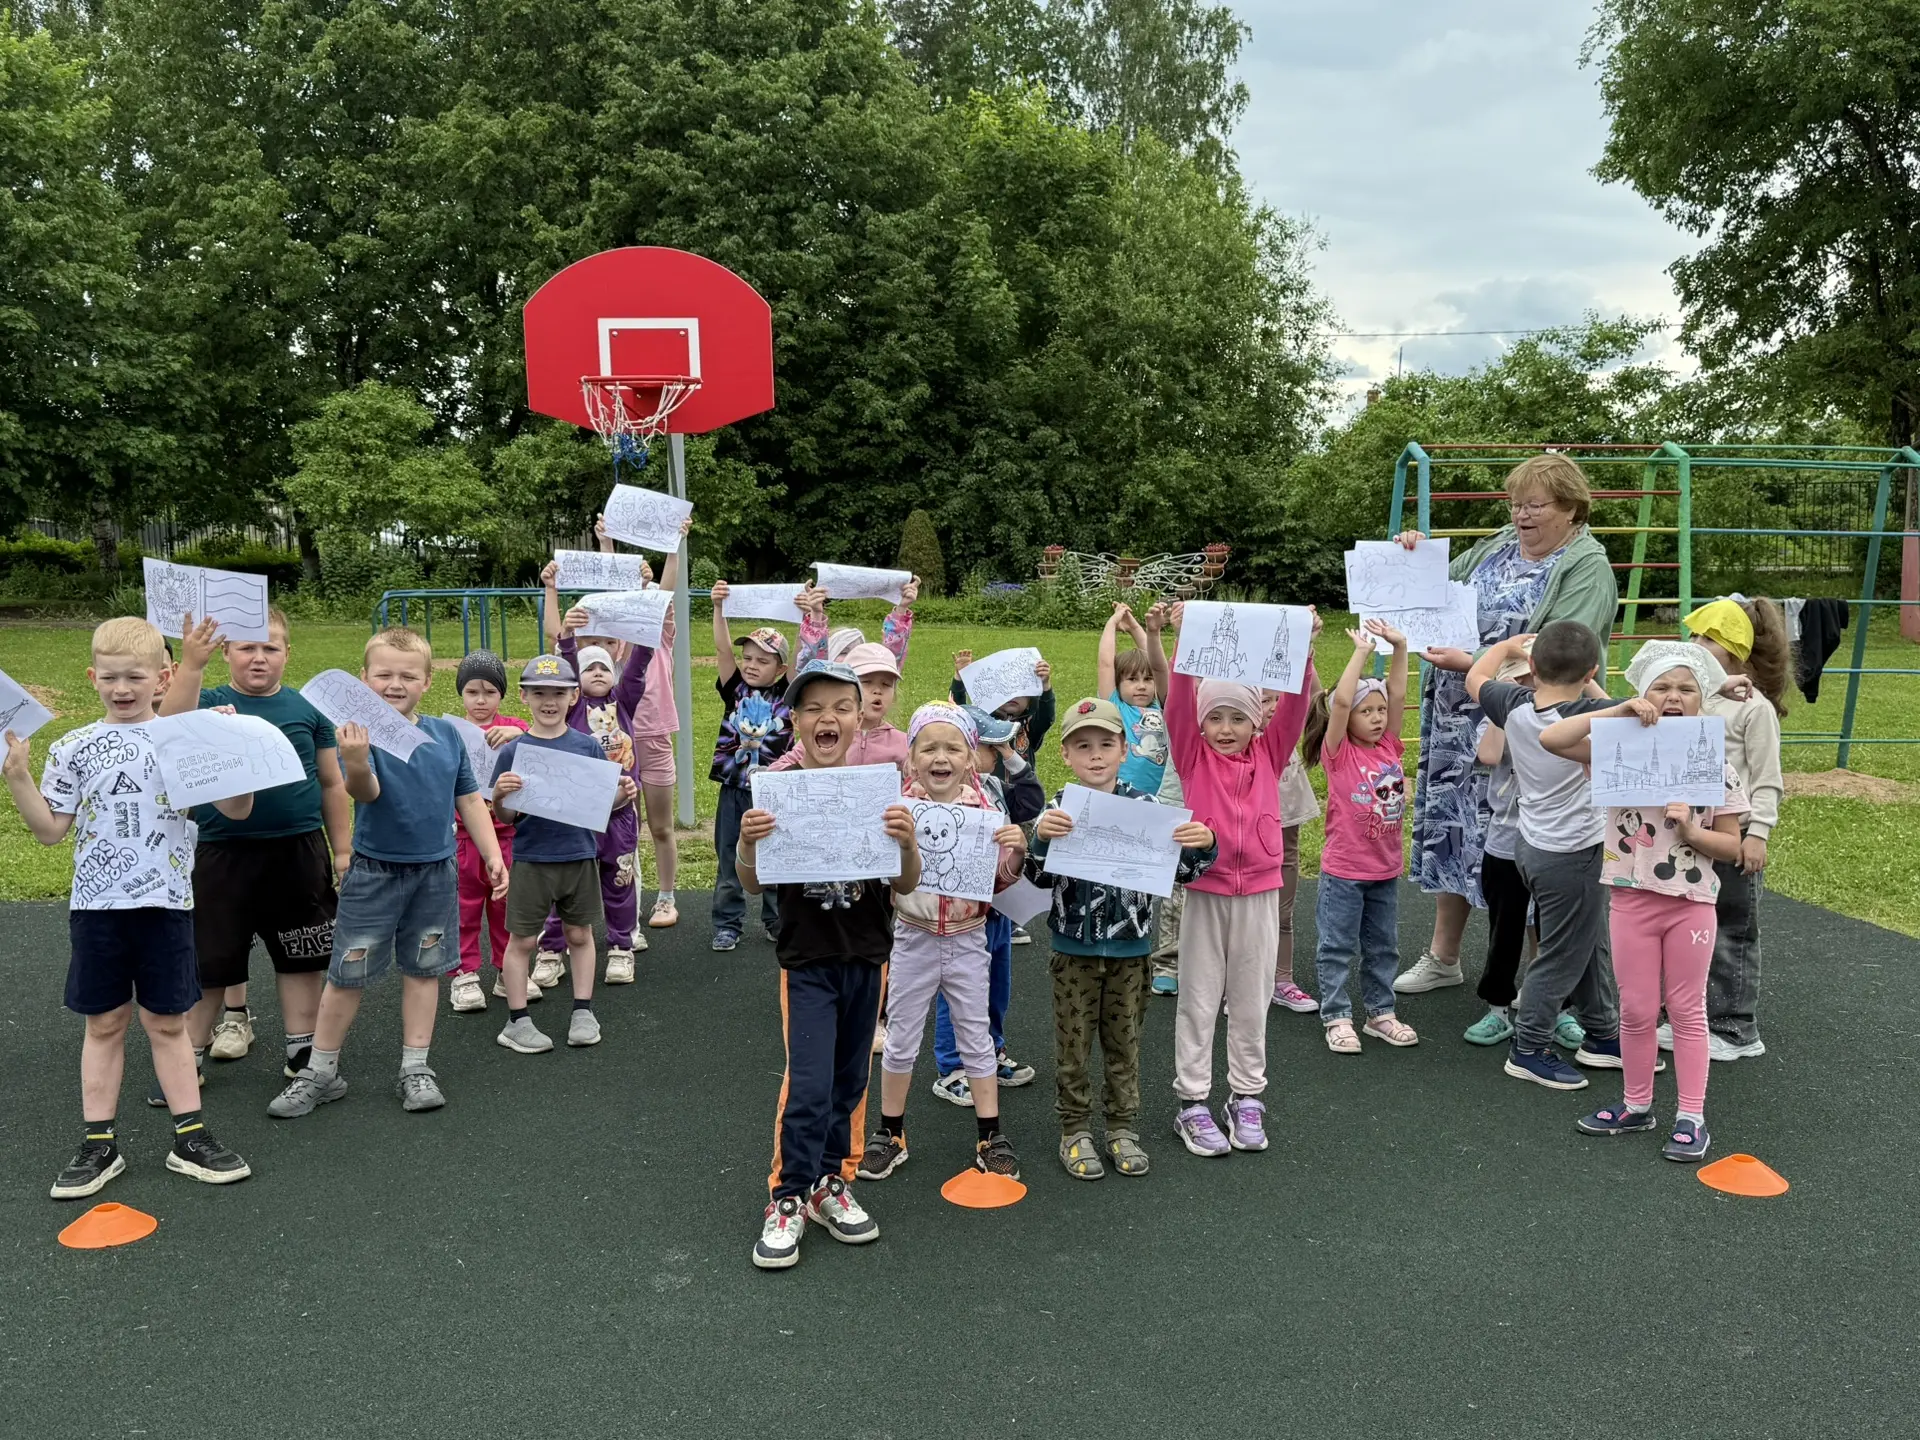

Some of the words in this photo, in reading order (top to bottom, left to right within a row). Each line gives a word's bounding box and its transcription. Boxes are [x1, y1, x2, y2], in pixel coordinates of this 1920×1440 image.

[176, 751, 219, 771] ДЕНЬ
[178, 756, 244, 782] РОССИИ
[194, 775, 219, 787] ИЮНЯ
[114, 801, 129, 838] RULES
[75, 847, 139, 910] CREATIVE
[120, 867, 161, 893] RULES
[302, 920, 329, 935] hard
[1690, 929, 1710, 945] Y-3
